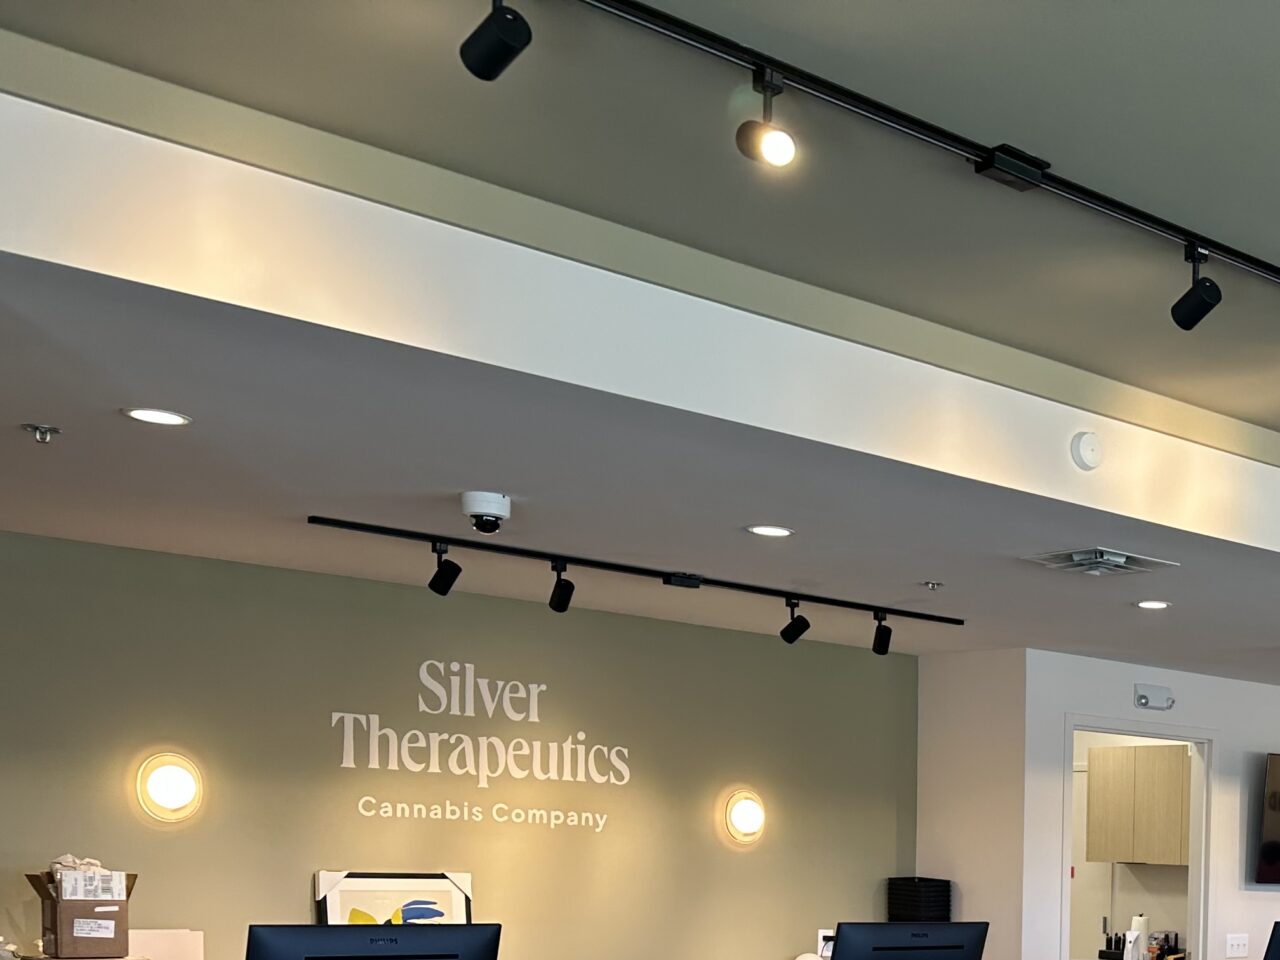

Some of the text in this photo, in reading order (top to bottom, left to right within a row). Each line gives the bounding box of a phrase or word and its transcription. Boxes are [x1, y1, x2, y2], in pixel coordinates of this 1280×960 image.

[418, 659, 547, 722] Silver
[331, 711, 630, 788] Therapeutics
[358, 796, 608, 832] Cannabis Company
